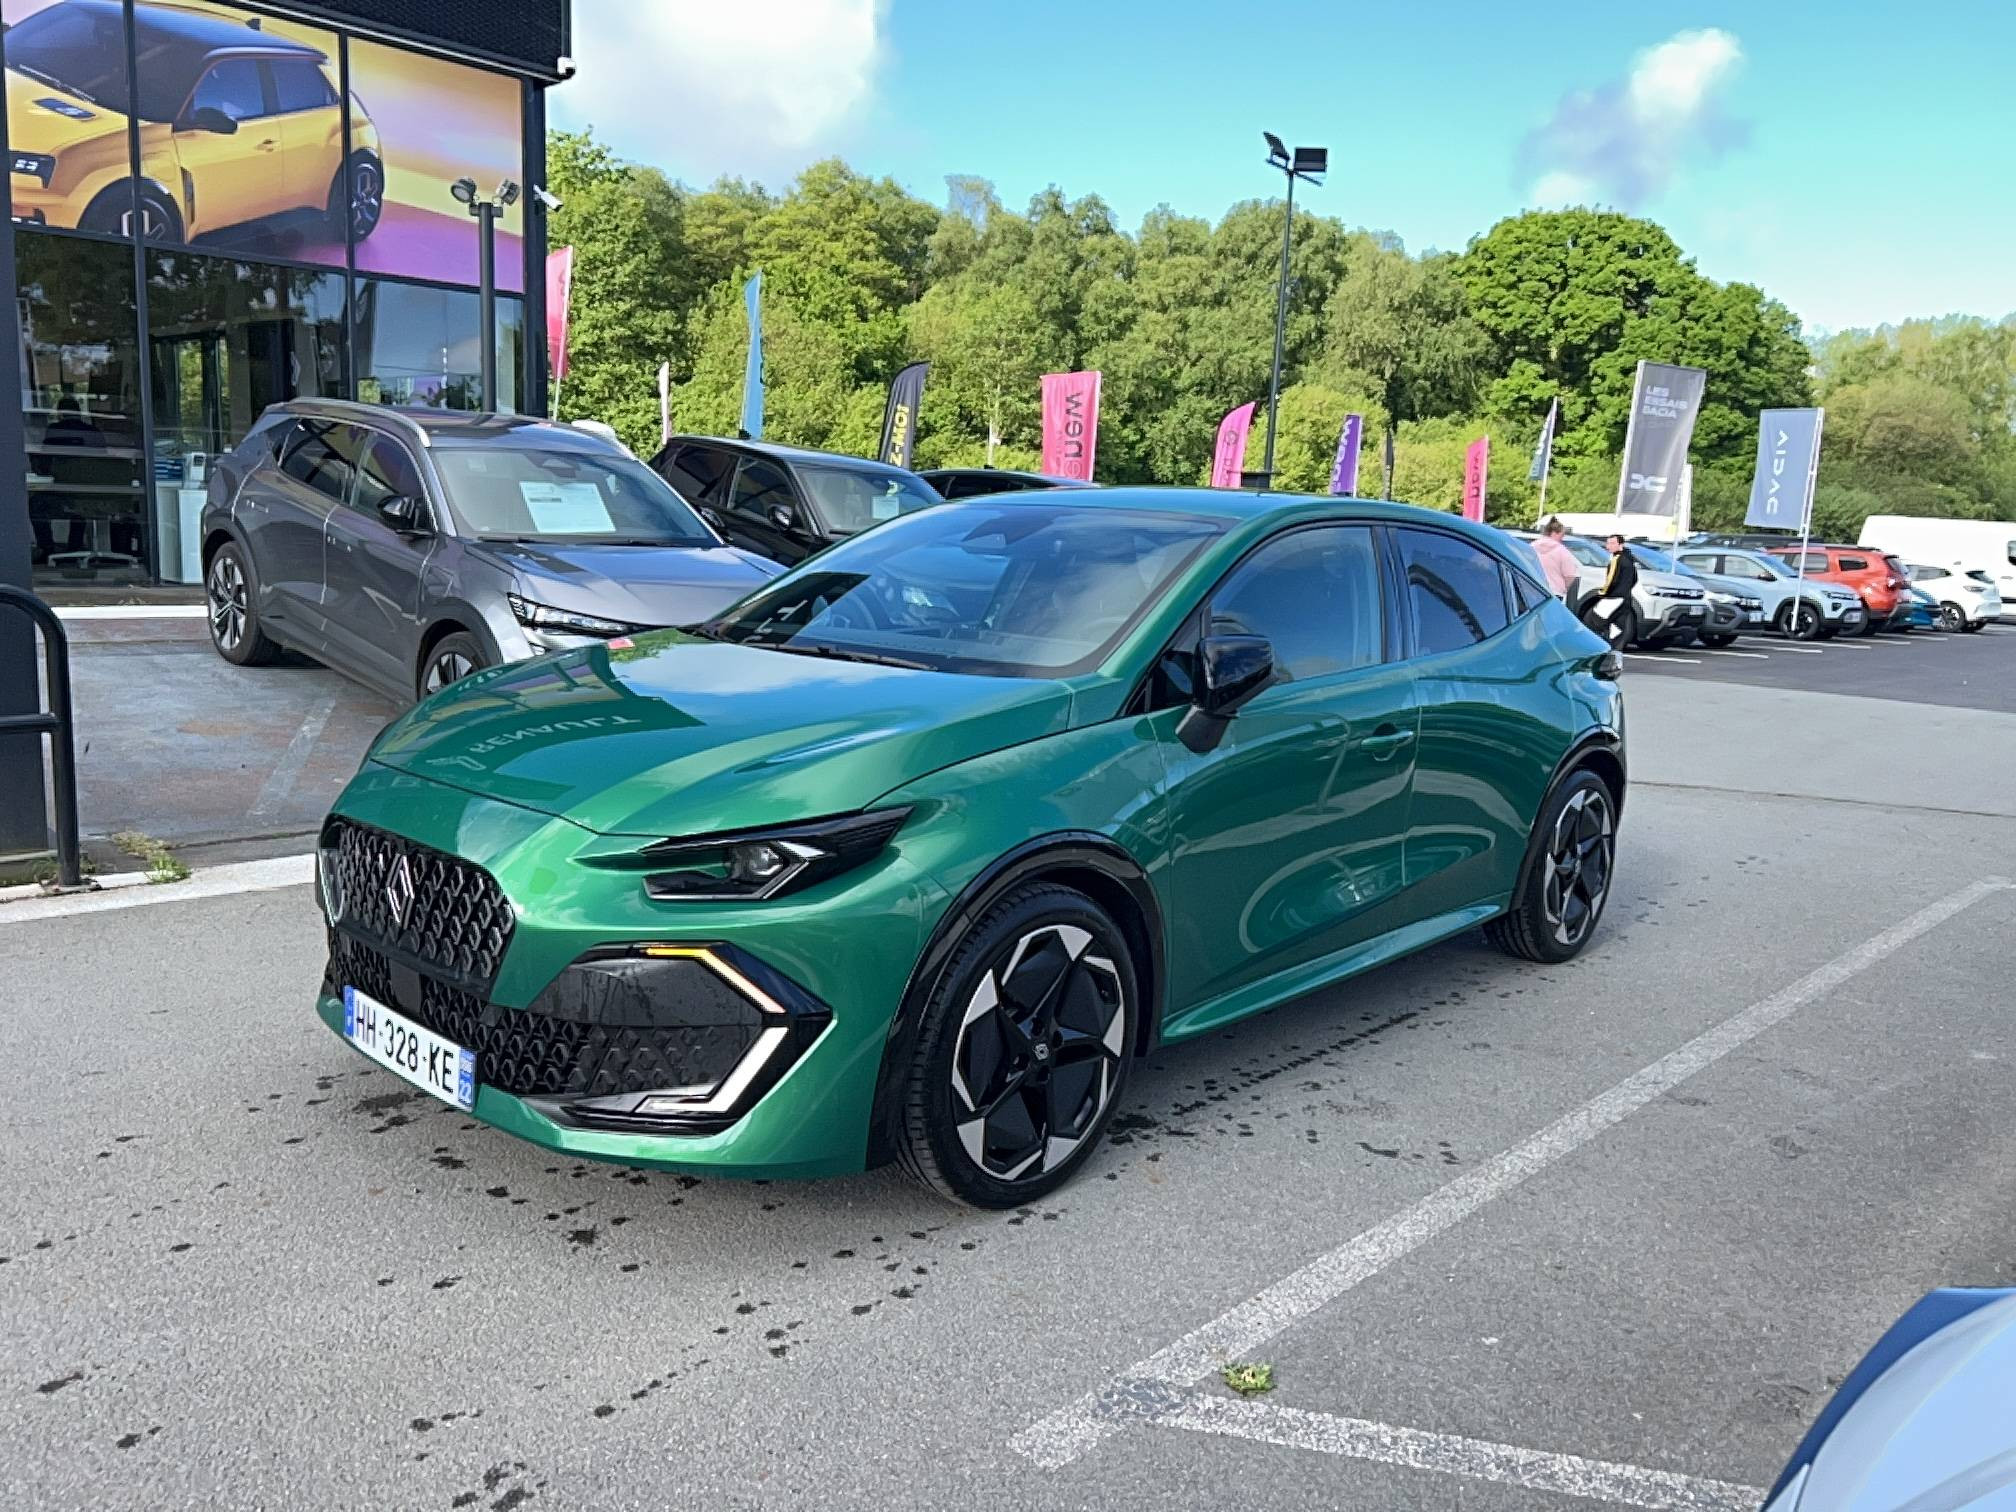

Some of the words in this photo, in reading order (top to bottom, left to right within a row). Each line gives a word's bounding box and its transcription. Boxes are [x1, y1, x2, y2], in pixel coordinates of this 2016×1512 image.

[1646, 385, 1669, 397] LES
[1644, 396, 1688, 410] ESSAIS
[356, 999, 454, 1094] HH-328-KE
